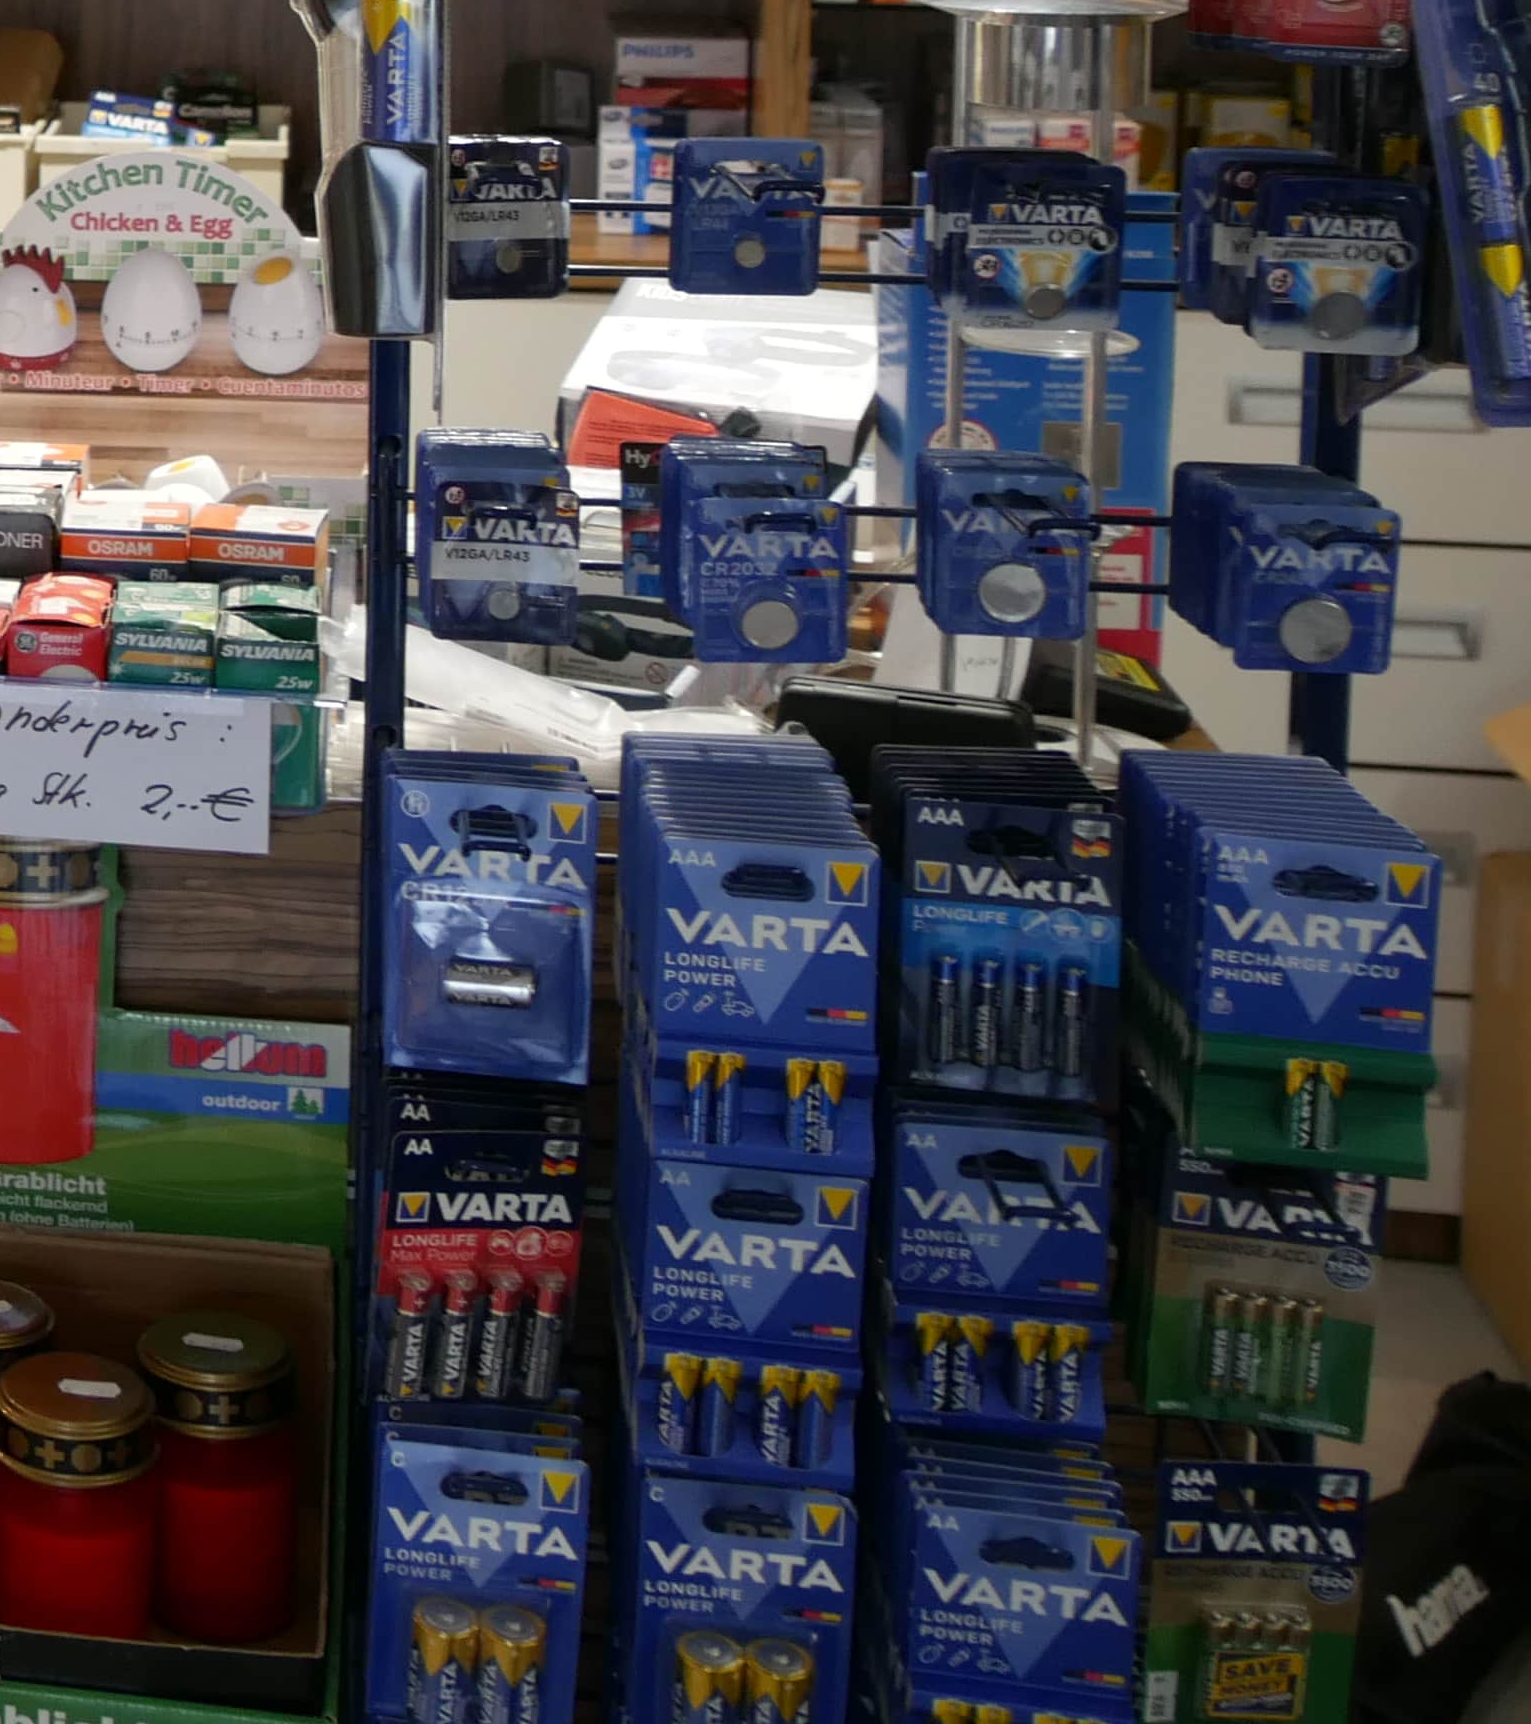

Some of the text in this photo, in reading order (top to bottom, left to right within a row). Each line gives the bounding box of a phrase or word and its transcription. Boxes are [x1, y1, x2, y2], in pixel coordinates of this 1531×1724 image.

[387, 33, 406, 124] VARTA
[108, 114, 168, 135] VARTA
[36, 159, 269, 225] Kitchen Timer
[1464, 144, 1483, 222] VARTA
[1010, 204, 1103, 225] VARTA
[70, 213, 233, 239] Chicken & Egg
[1310, 217, 1403, 241] VARTA
[25, 372, 113, 391] Minuteur
[138, 375, 193, 393] Timer
[219, 379, 367, 399] Cuentaminutos
[475, 518, 576, 547] VARTA
[87, 539, 153, 557] OSRAM
[218, 543, 285, 562] OSRAM
[445, 547, 530, 563] V12GA/LR43
[699, 534, 839, 558] VARTA
[700, 561, 777, 577] CR2032
[1251, 545, 1390, 573] VARTA
[38, 631, 84, 644] General
[115, 632, 208, 652] SYLVANIA
[38, 643, 84, 657] Electric
[220, 644, 315, 661] SYLVANIA
[917, 805, 965, 827] AAA
[668, 848, 717, 868] AAA
[1216, 844, 1270, 866] AAA
[398, 843, 588, 890] VARTA
[956, 864, 1112, 907] VARTA
[912, 904, 1010, 925] LONGLIFE
[667, 908, 869, 957] VARTA
[1213, 903, 1428, 960] VARTA
[664, 951, 766, 973] LONGLIFE
[1211, 948, 1401, 980] RECHARGE ACCU
[664, 968, 736, 988] POWER
[1211, 965, 1283, 987] PHONE
[168, 1028, 328, 1077] hellum
[201, 1091, 281, 1112] outdoor
[400, 1101, 430, 1122] AA
[803, 1082, 822, 1154] VARTA
[404, 1137, 433, 1155] AA
[905, 1134, 937, 1149] AA
[659, 1170, 691, 1187] AA
[34, 1196, 107, 1214] flackernd
[436, 1192, 573, 1224] VARTA
[10, 1209, 53, 1226] (ohne
[391, 1234, 477, 1248] LONGLIFE
[901, 1227, 1001, 1247] LONGLIFE
[391, 1247, 476, 1263] Max Power
[656, 1225, 856, 1278] VARTA
[901, 1243, 973, 1260] POWER
[653, 1266, 753, 1290] LONGLIFE
[652, 1283, 724, 1302] POWER
[402, 1323, 424, 1381] VARTA
[444, 1324, 467, 1382] VARTA
[1170, 1468, 1217, 1488] AAA
[387, 1506, 579, 1560] VARTA
[925, 1515, 959, 1532] AA
[1207, 1522, 1356, 1559] VARTA
[384, 1547, 482, 1569] LONGLIFE
[646, 1540, 844, 1593] VARTA
[384, 1563, 452, 1581] POWER
[644, 1580, 743, 1601] LONGLIFE
[923, 1568, 1128, 1628] VARTA
[644, 1595, 716, 1613] POWER
[1385, 1564, 1489, 1657] hama
[919, 1609, 1025, 1635] LONGLIFE
[919, 1625, 993, 1647] POWER
